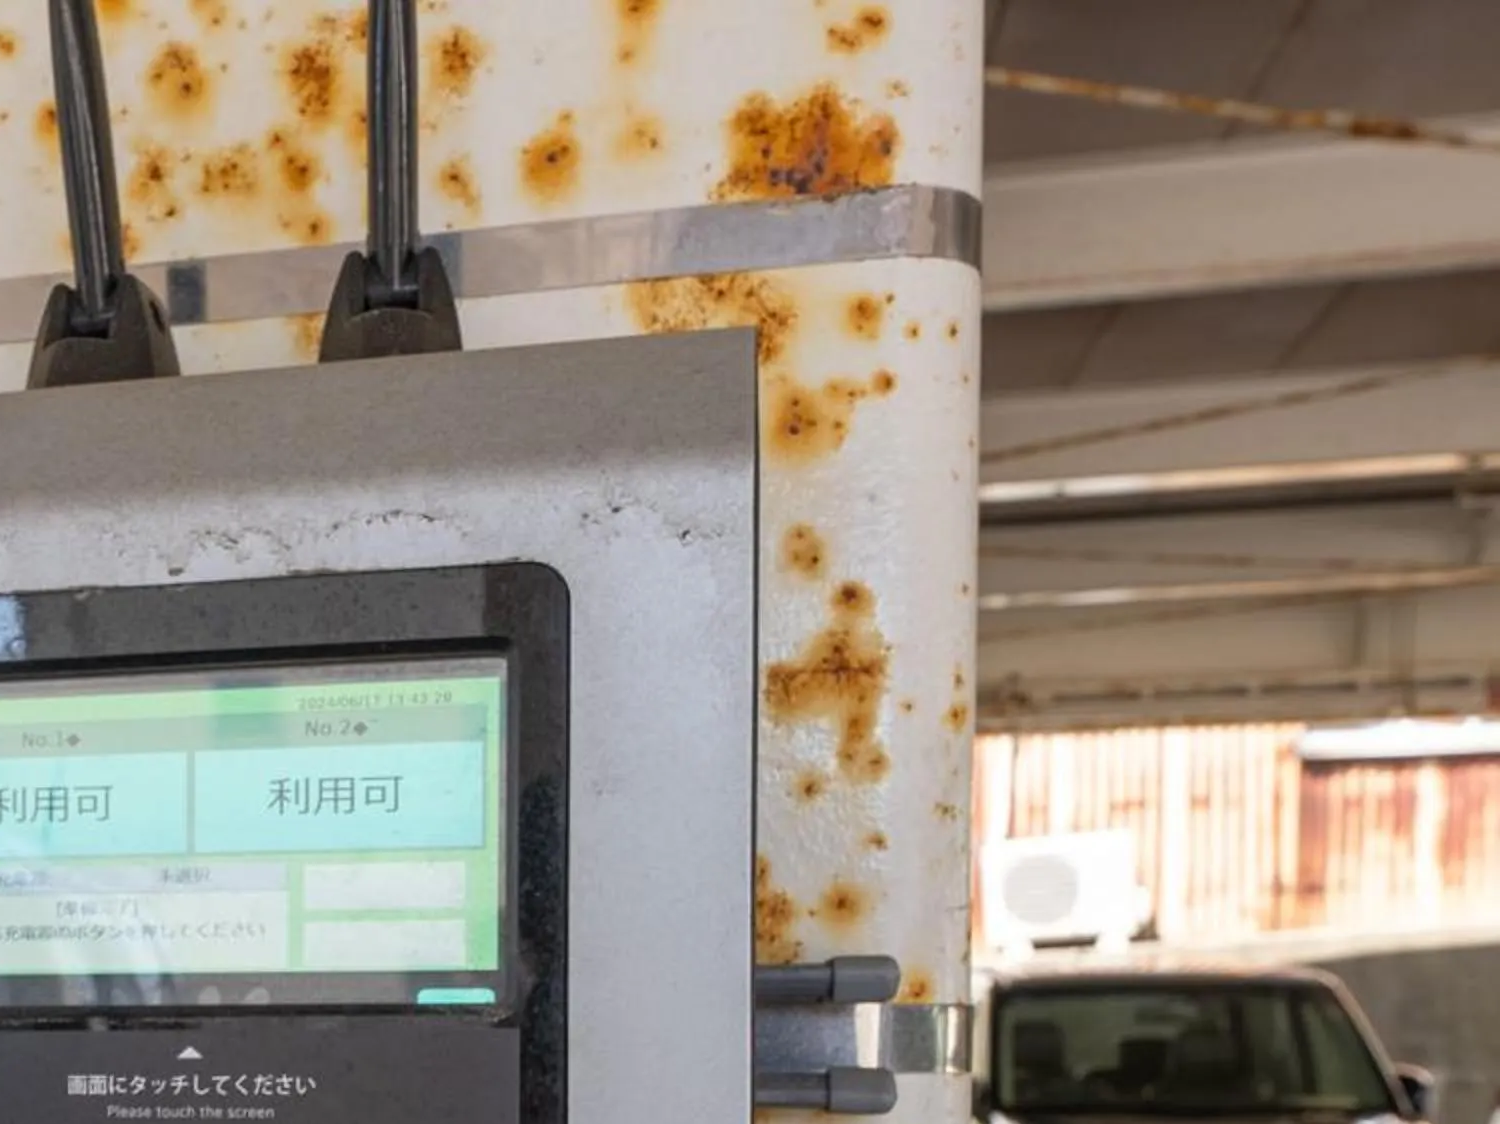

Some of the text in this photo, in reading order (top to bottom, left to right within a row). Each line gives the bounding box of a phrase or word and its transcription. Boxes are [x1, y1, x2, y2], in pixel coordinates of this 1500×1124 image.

[266, 775, 404, 816] 利用可
[67, 1073, 316, 1097] 画面にタッチしてください
[107, 1104, 275, 1120] Please touch the screen
